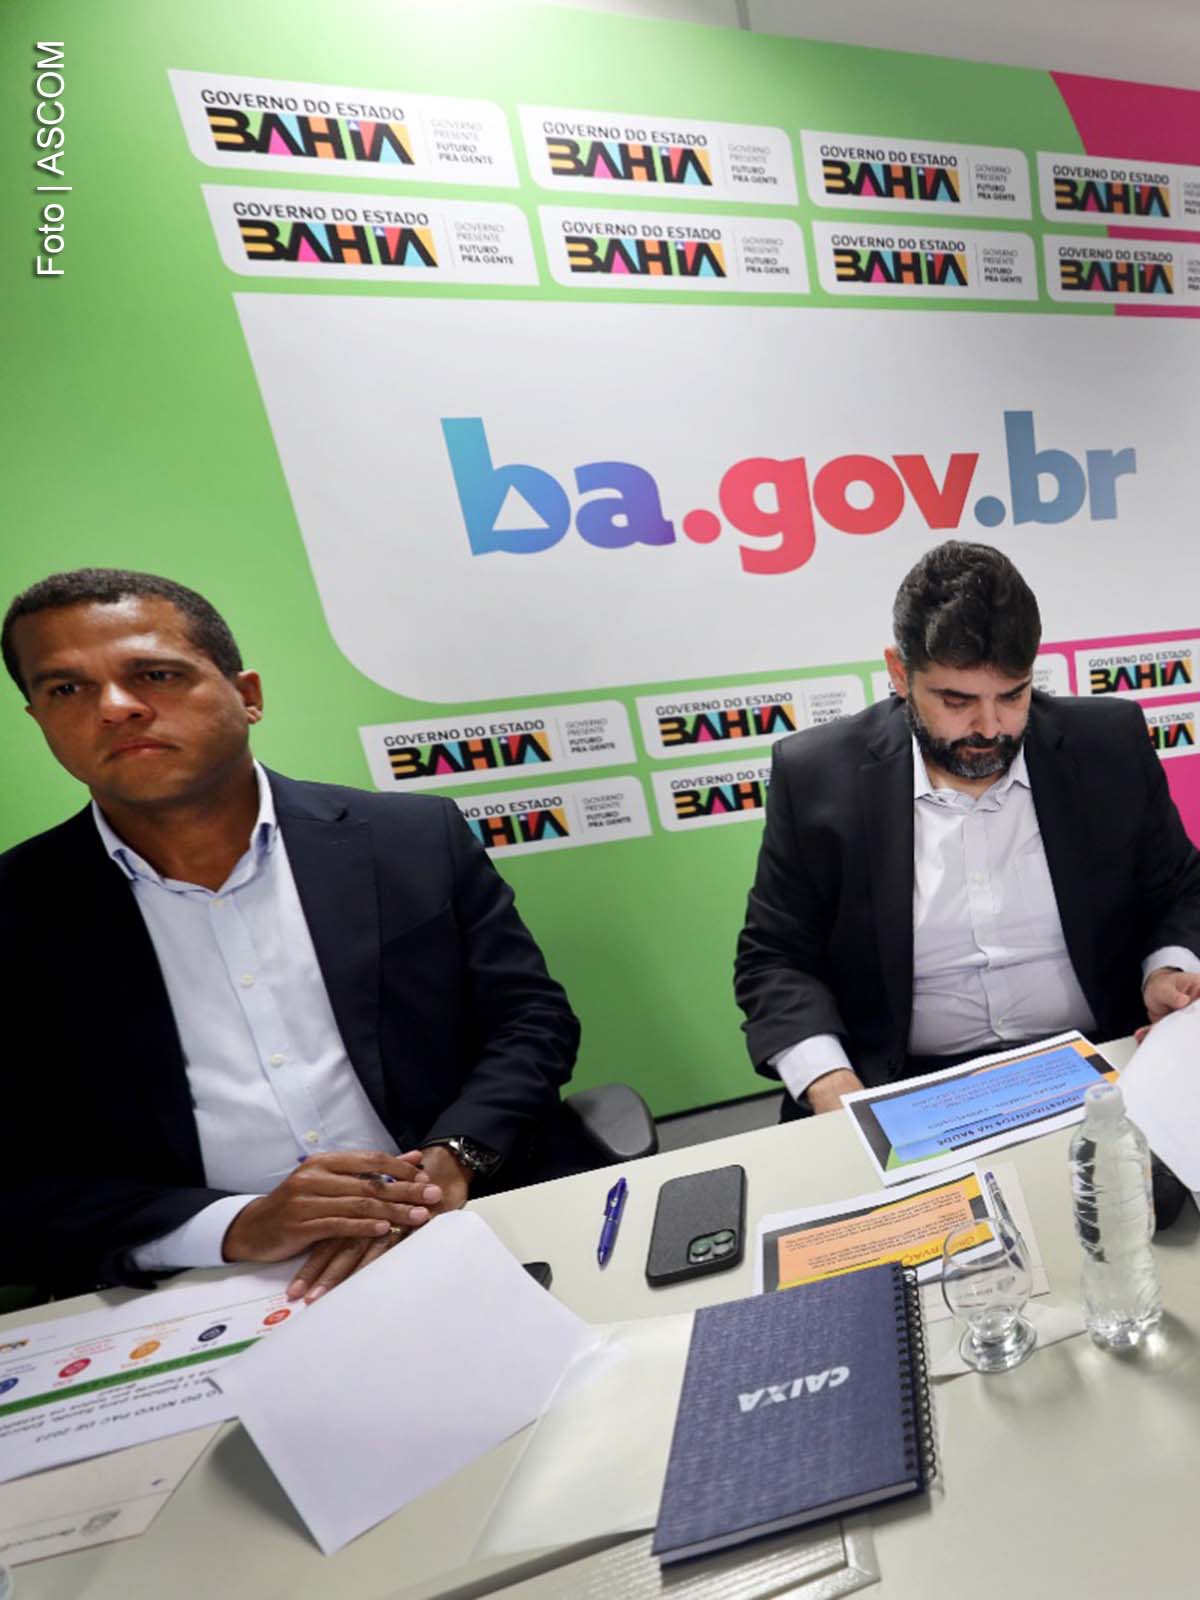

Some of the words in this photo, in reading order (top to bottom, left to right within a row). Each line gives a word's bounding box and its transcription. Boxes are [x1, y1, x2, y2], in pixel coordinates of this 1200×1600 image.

[199, 88, 300, 112] GOVERNO
[302, 97, 332, 114] DO
[334, 101, 405, 120] ESTADO
[205, 107, 415, 165] BAHIA
[542, 121, 621, 140] GOVERNO
[624, 127, 647, 142] DO
[650, 130, 707, 146] ESTADO
[545, 137, 713, 186] BAHIA
[819, 145, 885, 161] GOVERNO
[888, 150, 907, 163] DO
[909, 152, 957, 166] ESTADO
[822, 159, 960, 203] BAHIA
[1052, 164, 1108, 180] GOVERNO
[1110, 169, 1126, 181] DO
[1128, 171, 1169, 184] ESTADO
[231, 201, 328, 220] GOVERNO
[330, 206, 359, 221] DO
[361, 208, 429, 225] ESTADO
[1054, 178, 1170, 218] BAHIA
[237, 219, 439, 268] BAHIA
[561, 220, 638, 236] GOVERNO
[641, 224, 663, 237] DO
[665, 225, 721, 239] ESTADO
[831, 234, 895, 248] GOVERNO
[897, 237, 916, 249] DO
[918, 238, 965, 251] ESTADO
[458, 244, 500, 255] FUTURO
[482, 255, 514, 265] GENTE
[564, 236, 727, 278] BAHIA
[1058, 246, 1113, 259] GOVERNO
[1115, 249, 1131, 260] DO
[1133, 250, 1172, 262] ESTADO
[833, 248, 968, 286] BAHIA
[1059, 259, 1174, 294] BAHIA
[440, 410, 1137, 576] ba.gov.br
[1088, 653, 1137, 668] GOVERNO
[1139, 652, 1153, 662] DO
[1155, 648, 1190, 661] ESTADO
[1089, 658, 1191, 695] BAHIA
[654, 698, 721, 717] GOVERNO
[723, 696, 743, 708] DO
[745, 690, 792, 706] ESTADO
[1159, 710, 1193, 724] ESTADO
[382, 727, 461, 748] GOVERNO
[463, 724, 486, 738] DO
[488, 718, 545, 735] ESTADO
[657, 701, 796, 747] BAHIA
[387, 730, 552, 780] BAHIA
[669, 772, 734, 790] GOVERNO
[735, 770, 754, 781] DO
[481, 802, 505, 815] DO
[507, 795, 563, 812] ESTADO
[737, 1366, 850, 1412] CAIXA
